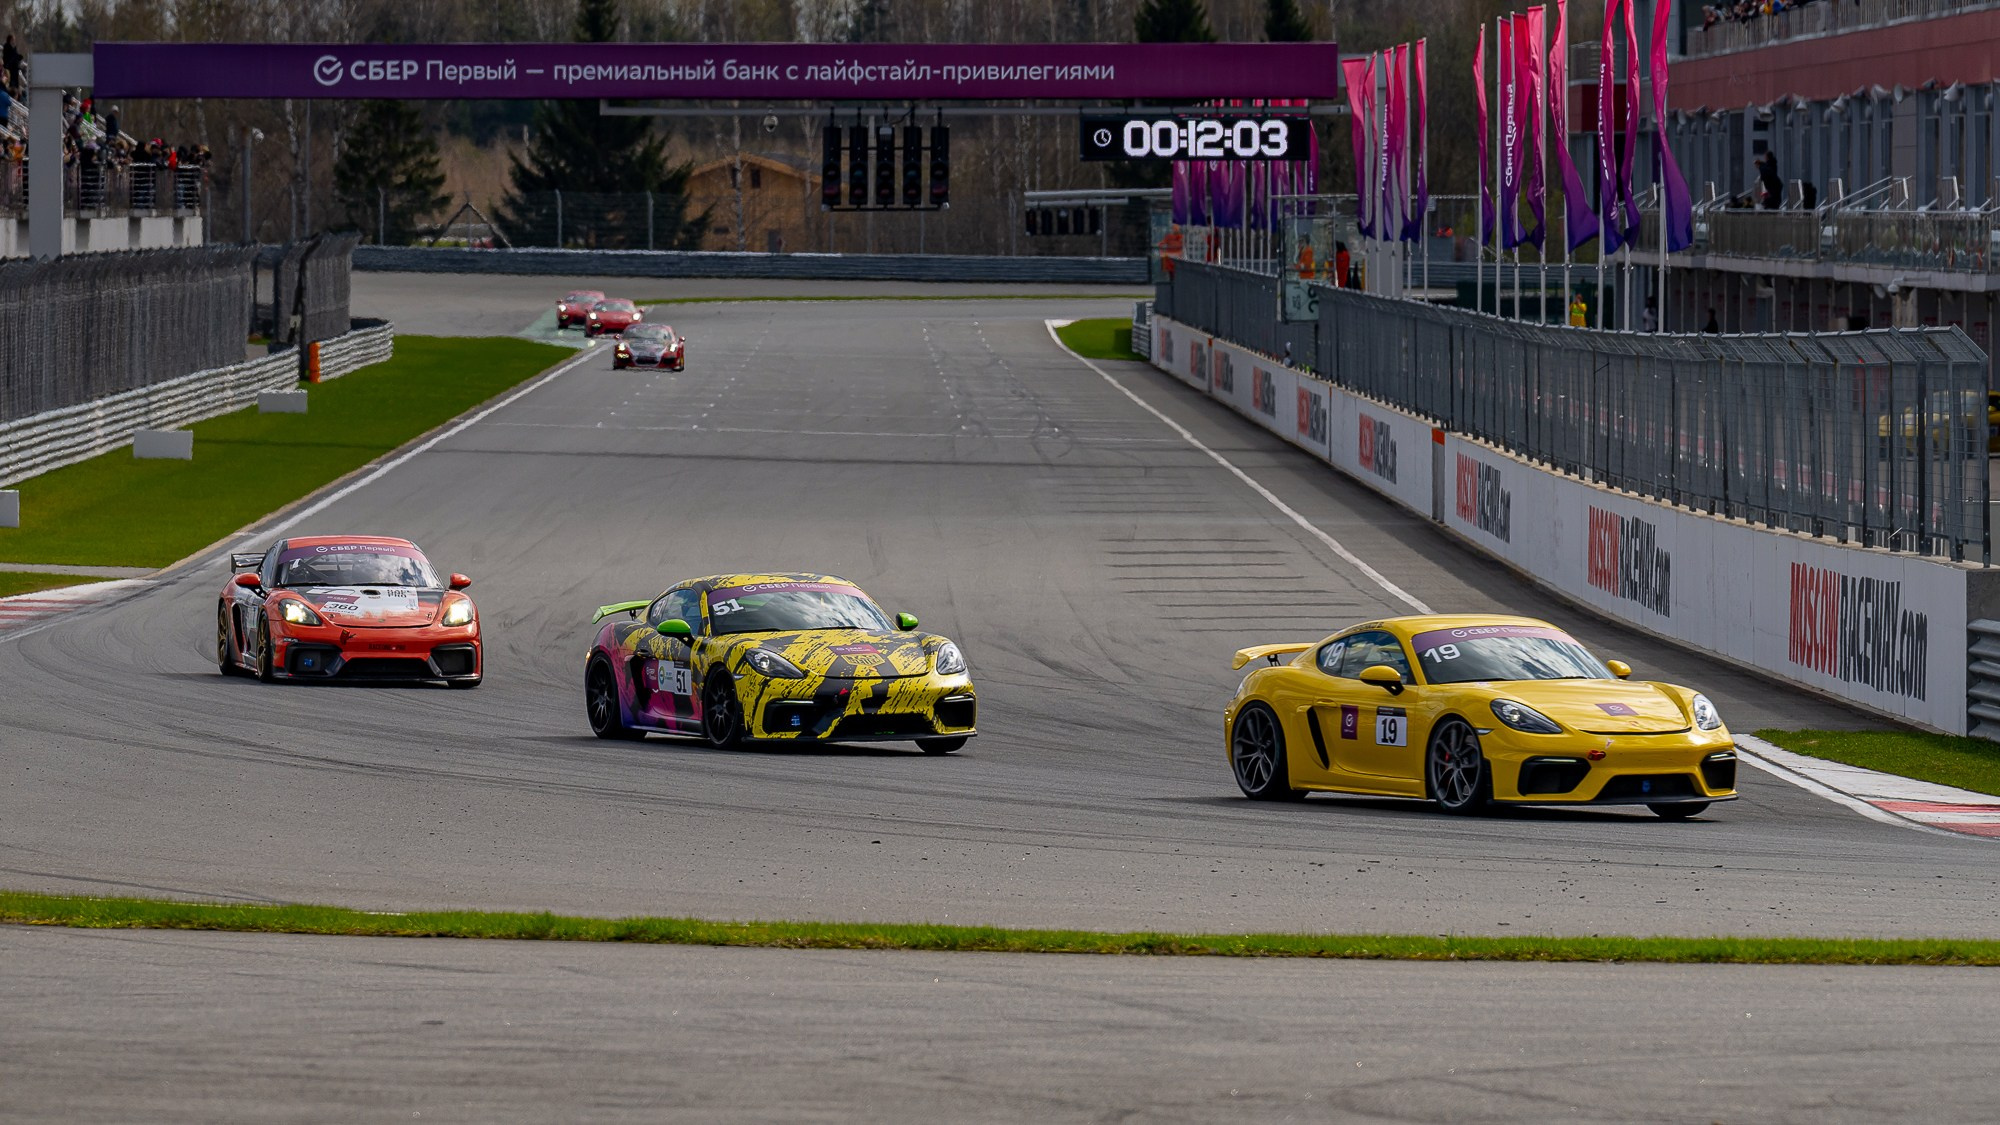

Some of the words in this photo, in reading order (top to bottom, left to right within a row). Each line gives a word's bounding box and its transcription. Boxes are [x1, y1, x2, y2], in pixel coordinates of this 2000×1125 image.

[350, 60, 419, 81] СБЕР
[427, 59, 517, 85] Первый
[554, 58, 716, 84] премиальный
[722, 59, 779, 81] банк
[786, 65, 799, 81] с
[804, 60, 1115, 86] лайфстайл-привилегиями
[1123, 119, 1289, 157] 00:12:03
[712, 598, 745, 616] 51
[1468, 627, 1500, 635] СБЕР
[1323, 642, 1346, 667] 19
[1424, 643, 1462, 664] 19
[676, 670, 687, 693] 51
[1381, 718, 1398, 744] 19
